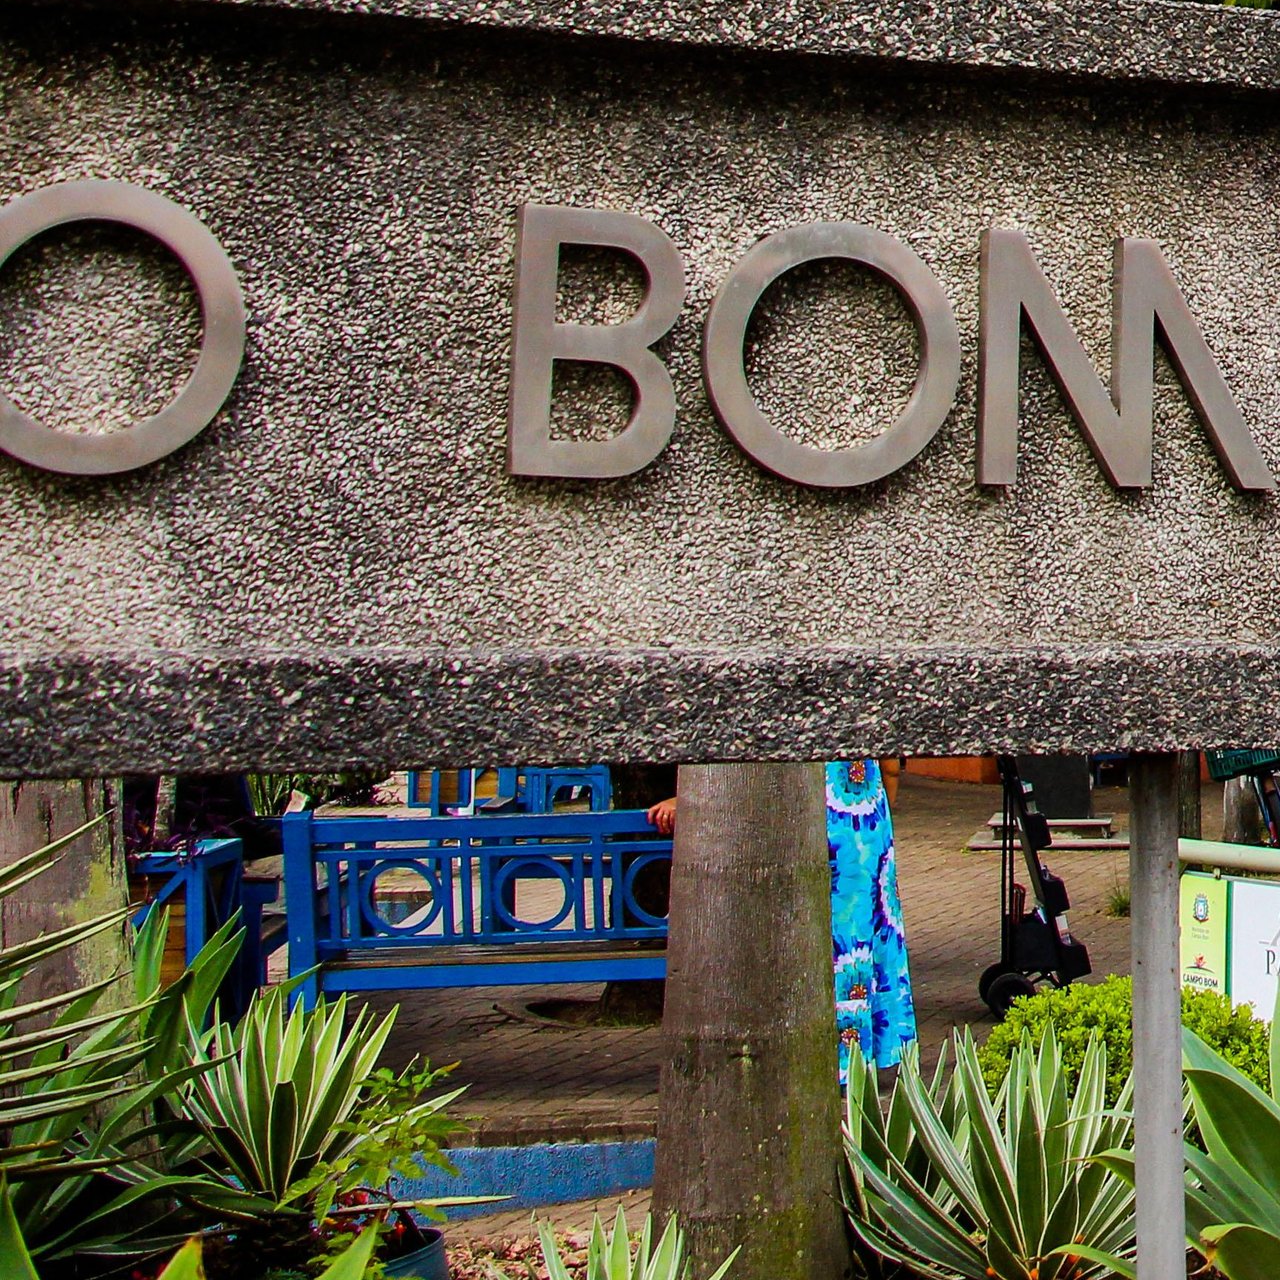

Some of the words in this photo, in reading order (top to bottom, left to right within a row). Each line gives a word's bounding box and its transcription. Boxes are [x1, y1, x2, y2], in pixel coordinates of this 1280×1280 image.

[506, 202, 1276, 490] BOM
[1183, 973, 1203, 985] CAMPO
[1204, 977, 1218, 988] BOM
